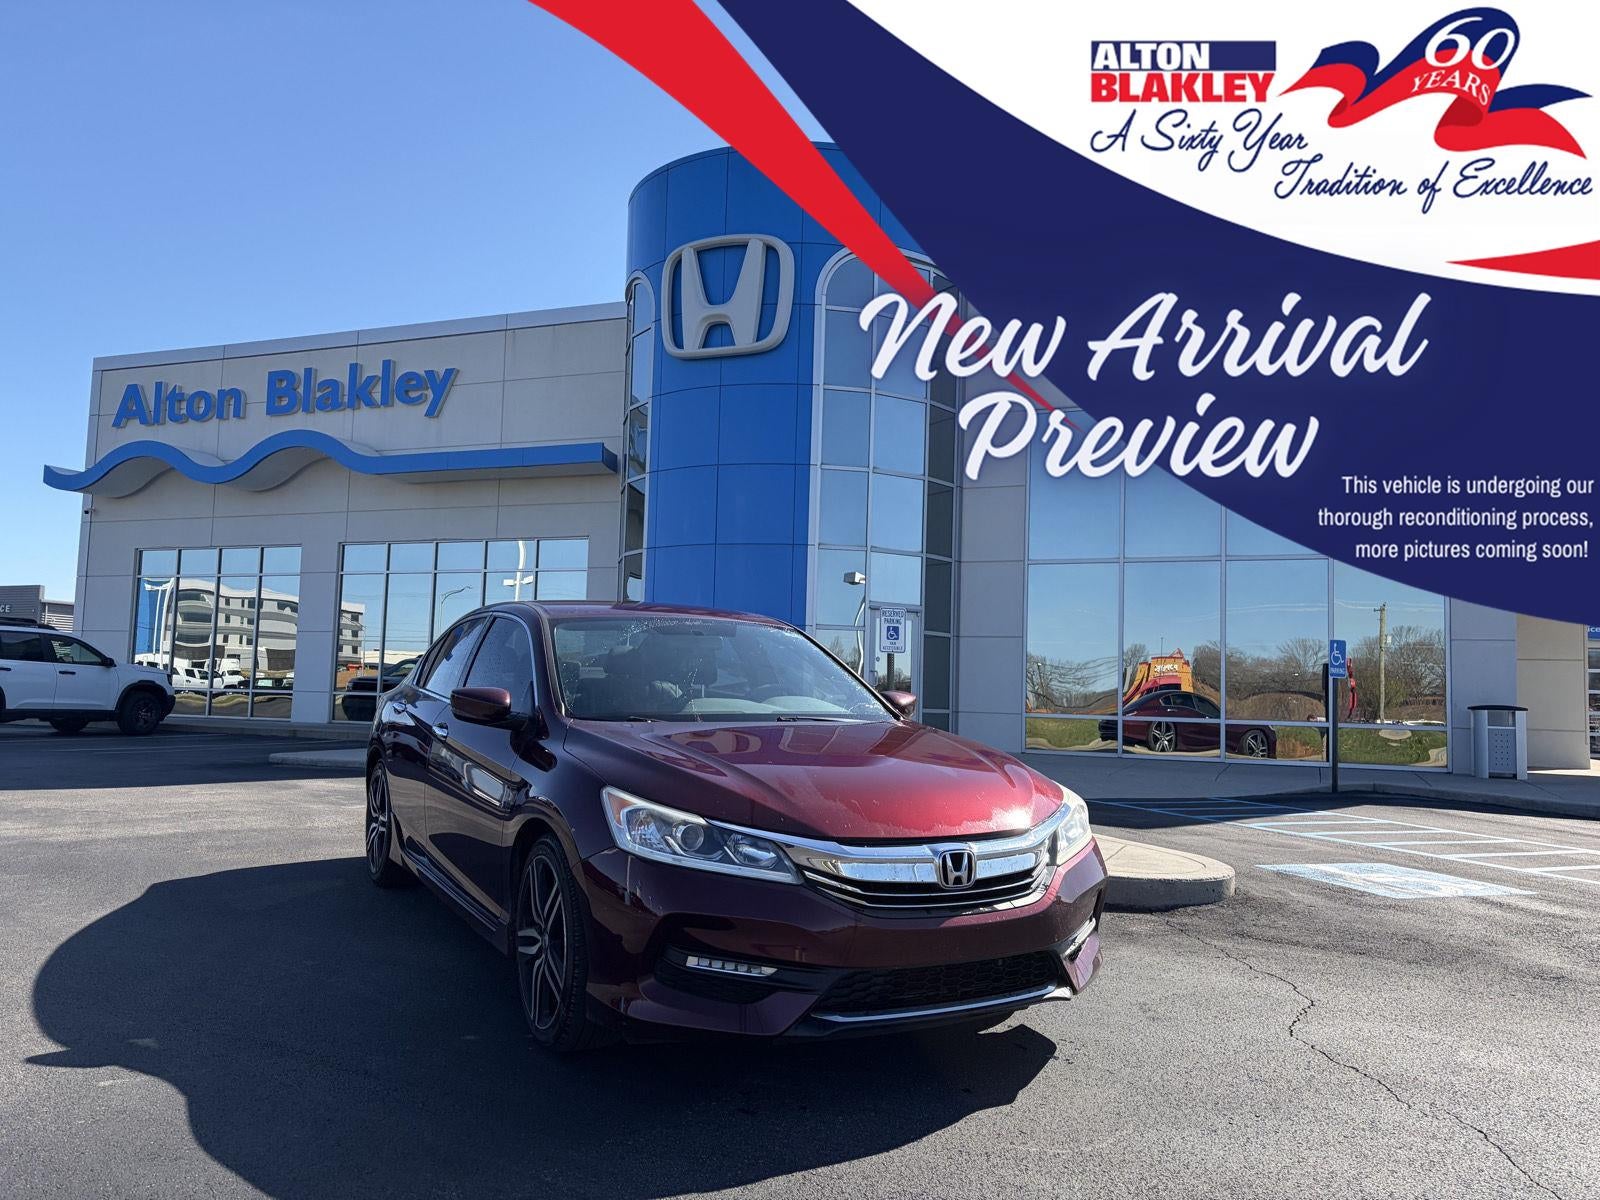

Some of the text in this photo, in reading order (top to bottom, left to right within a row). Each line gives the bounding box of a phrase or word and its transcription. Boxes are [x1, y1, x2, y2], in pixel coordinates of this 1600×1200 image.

[112, 359, 459, 428] Alton Blakley
[881, 610, 904, 618] RESERVED
